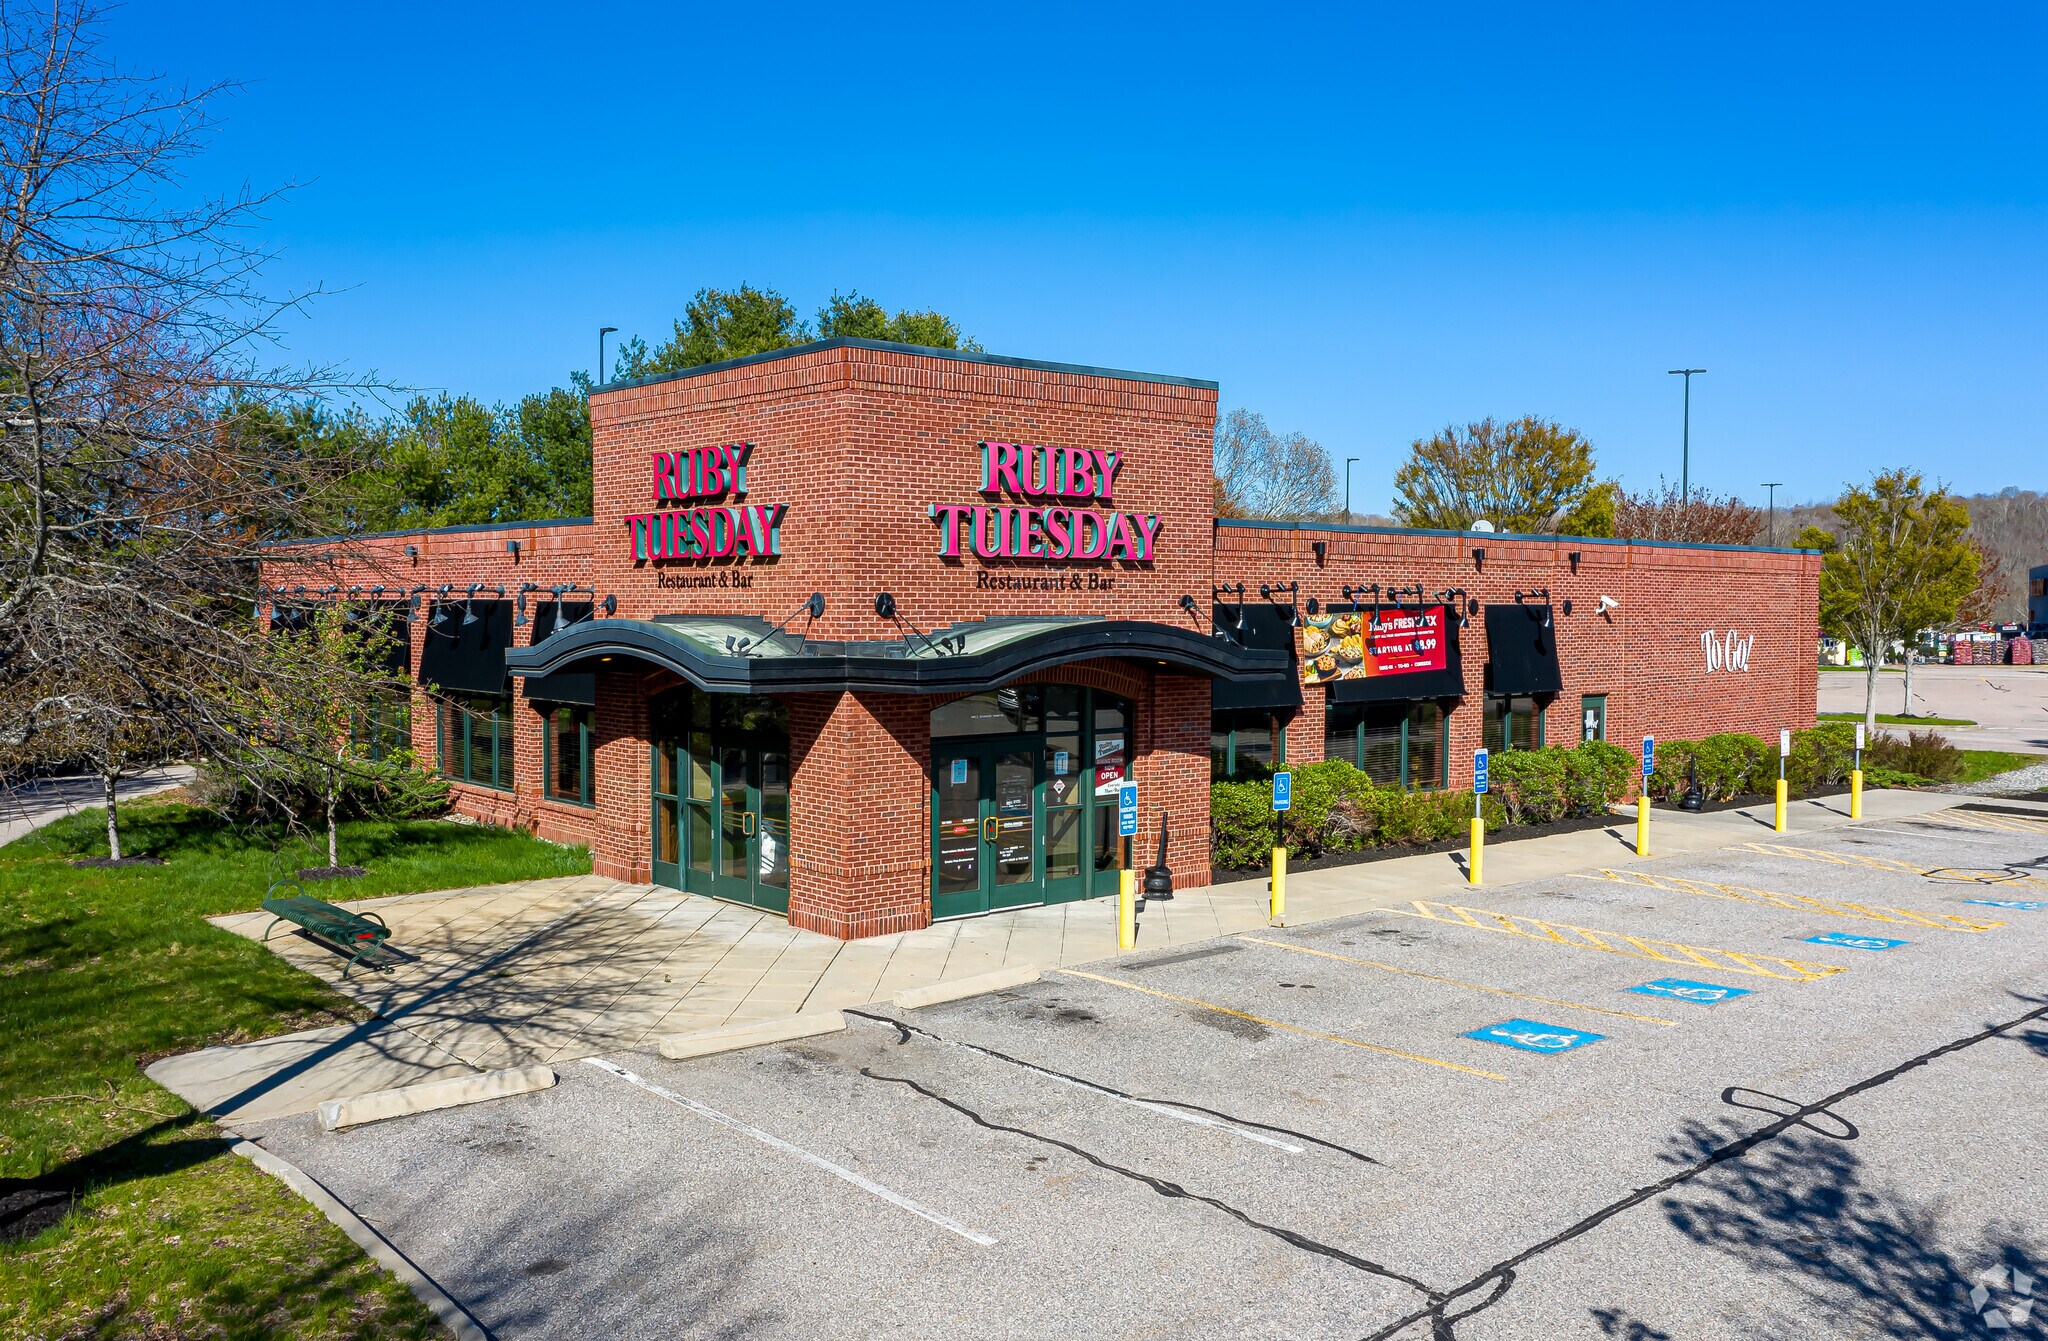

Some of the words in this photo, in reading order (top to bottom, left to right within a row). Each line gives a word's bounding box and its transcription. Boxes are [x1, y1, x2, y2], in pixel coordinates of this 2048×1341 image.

[651, 442, 754, 500] RUBY
[977, 441, 1123, 498] RUBY
[624, 504, 789, 560] TUESDAY
[928, 504, 1162, 560] TUESDAY
[658, 572, 716, 589] Restaurant
[719, 571, 728, 588] &
[732, 570, 753, 588] Bar
[976, 571, 1065, 590] Restaurant
[1069, 573, 1083, 590] &
[1088, 573, 1115, 590] Bar
[1369, 645, 1403, 655] STARTING
[1405, 644, 1412, 652] AT
[1700, 629, 1722, 674] To
[1725, 629, 1754, 673] Go!
[1101, 772, 1119, 780] OPEN
